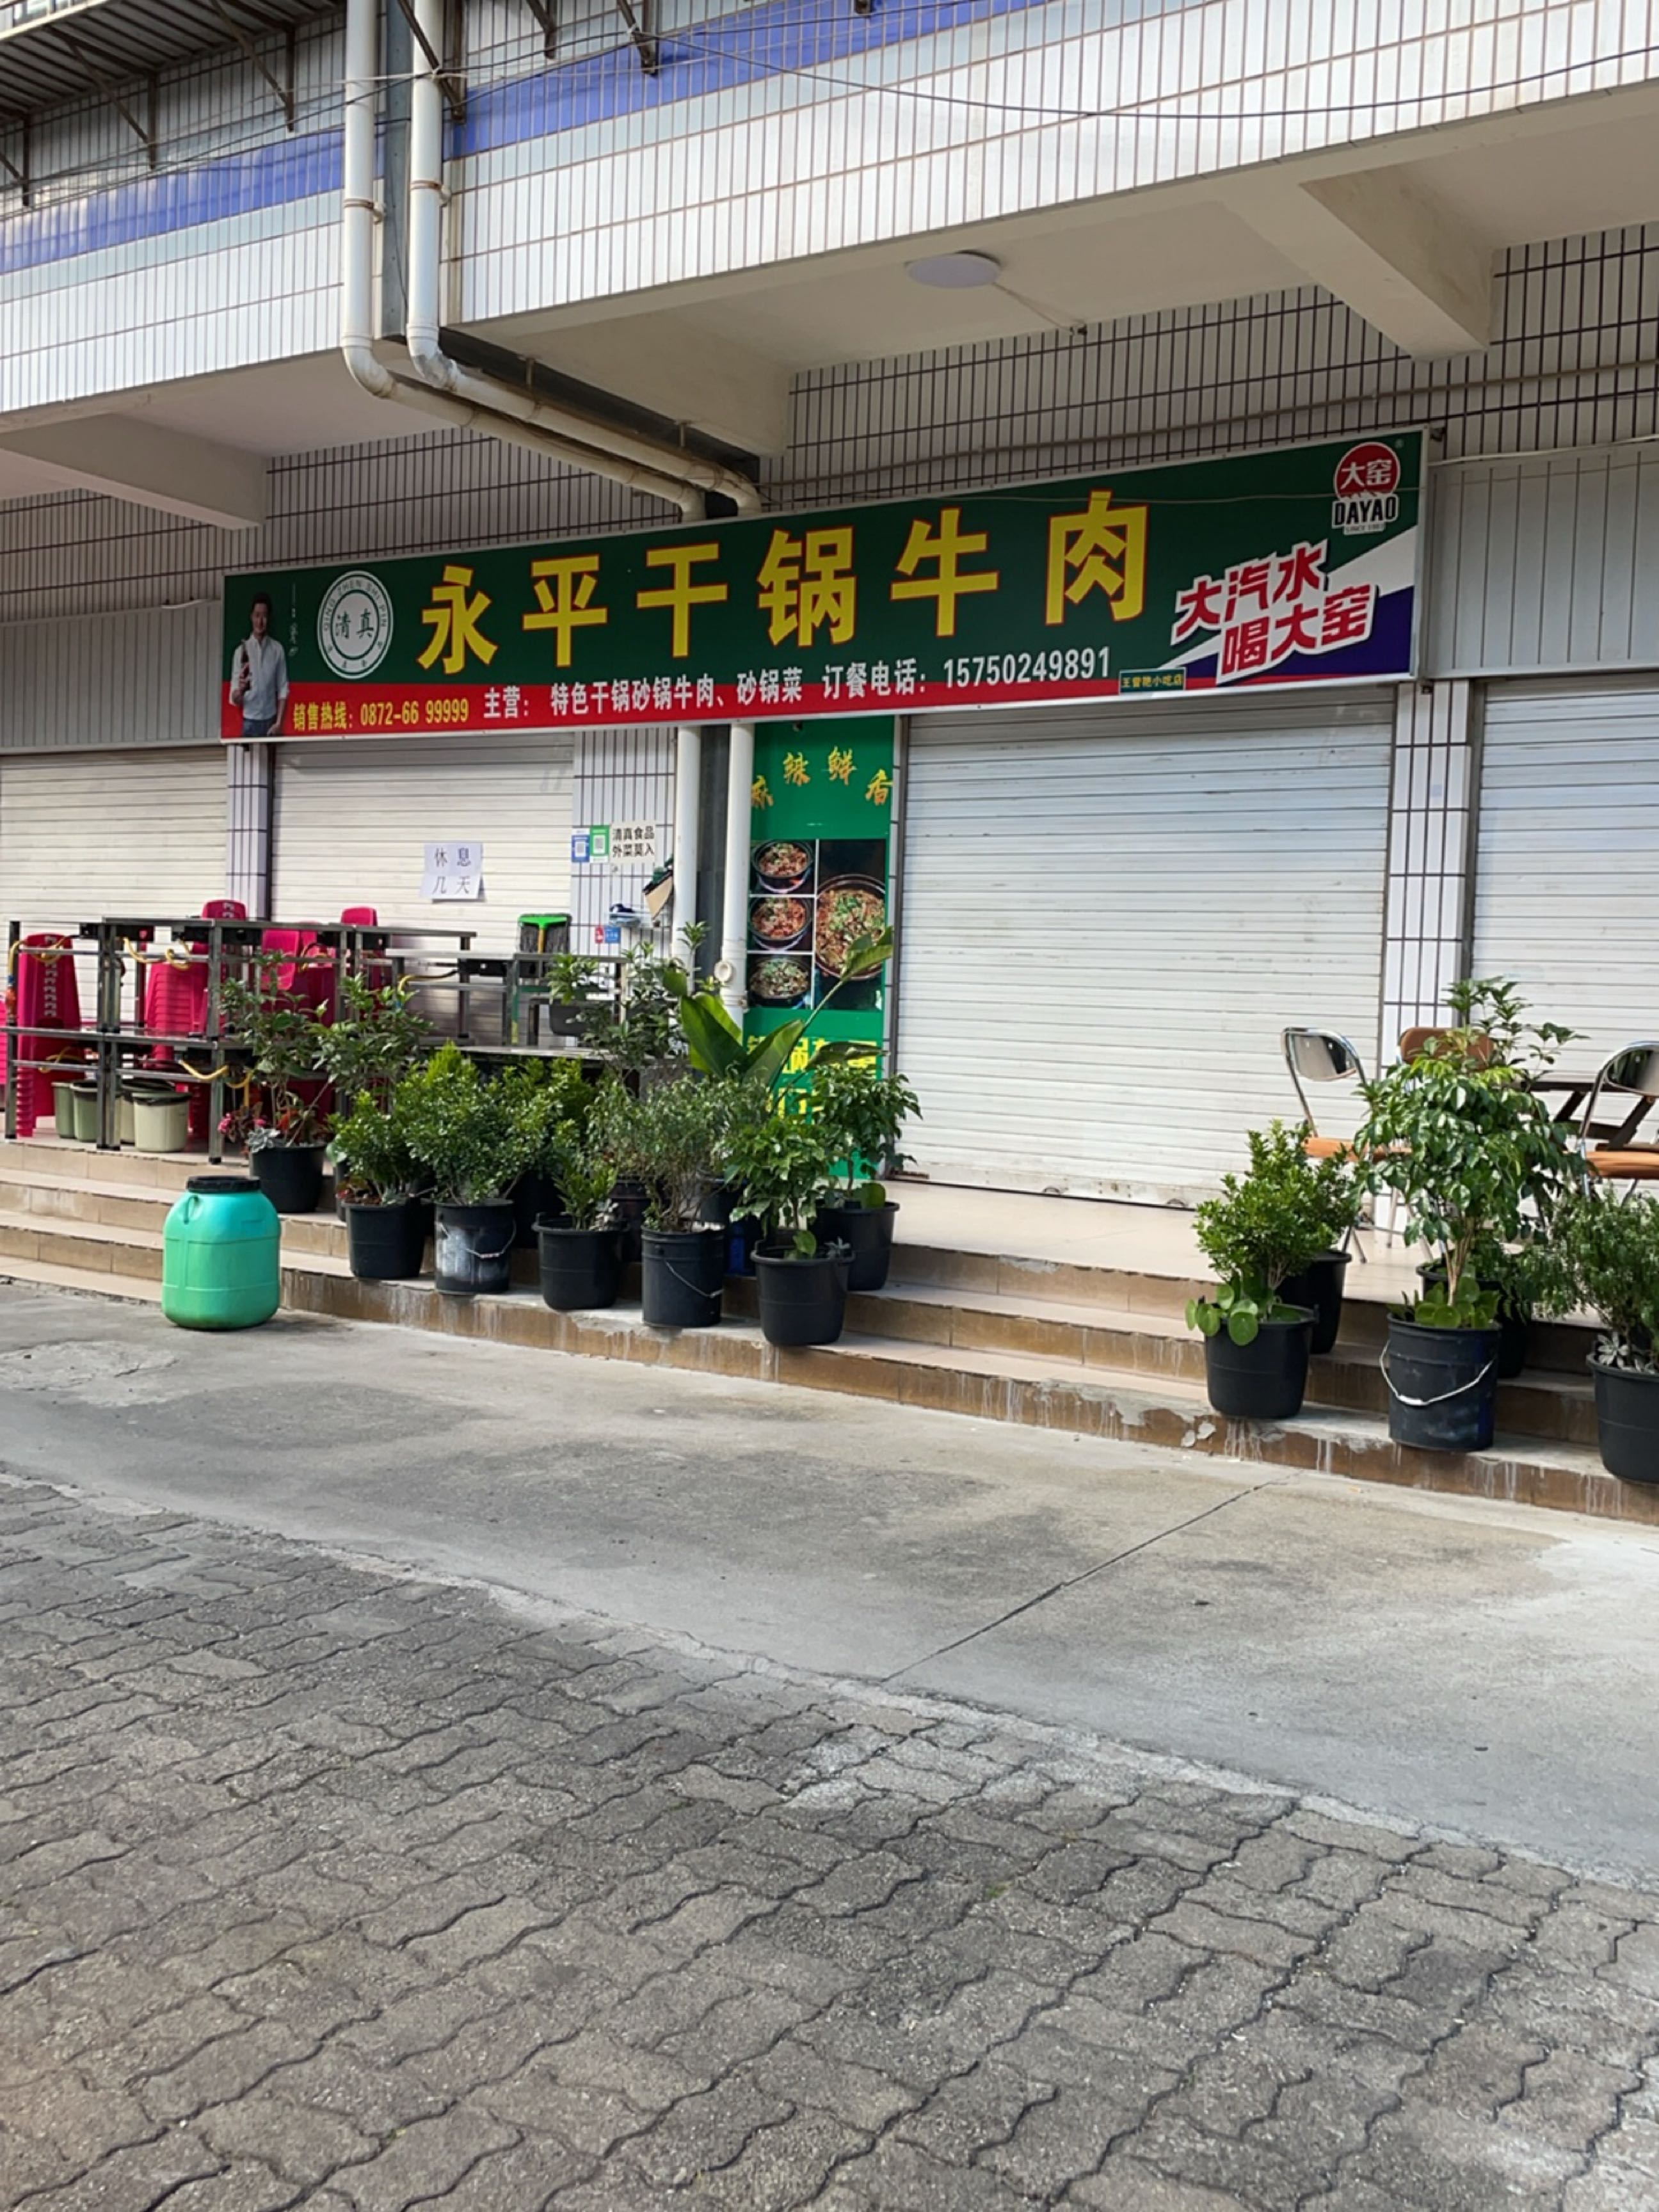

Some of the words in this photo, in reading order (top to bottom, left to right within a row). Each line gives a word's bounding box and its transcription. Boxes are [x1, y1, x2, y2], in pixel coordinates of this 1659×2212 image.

[1340, 458, 1392, 490] 大窑
[1334, 496, 1396, 525] DAYAO
[417, 488, 1149, 674] 永平干锅牛肉
[1173, 543, 1324, 640] 大汽水
[335, 608, 374, 639] 清真
[1220, 583, 1372, 677] 喝大窑
[943, 646, 1110, 688] 15750249891
[425, 697, 469, 725] 99999
[613, 825, 655, 840] 清真食品
[435, 847, 472, 867] 休息
[431, 875, 470, 895] 几天
